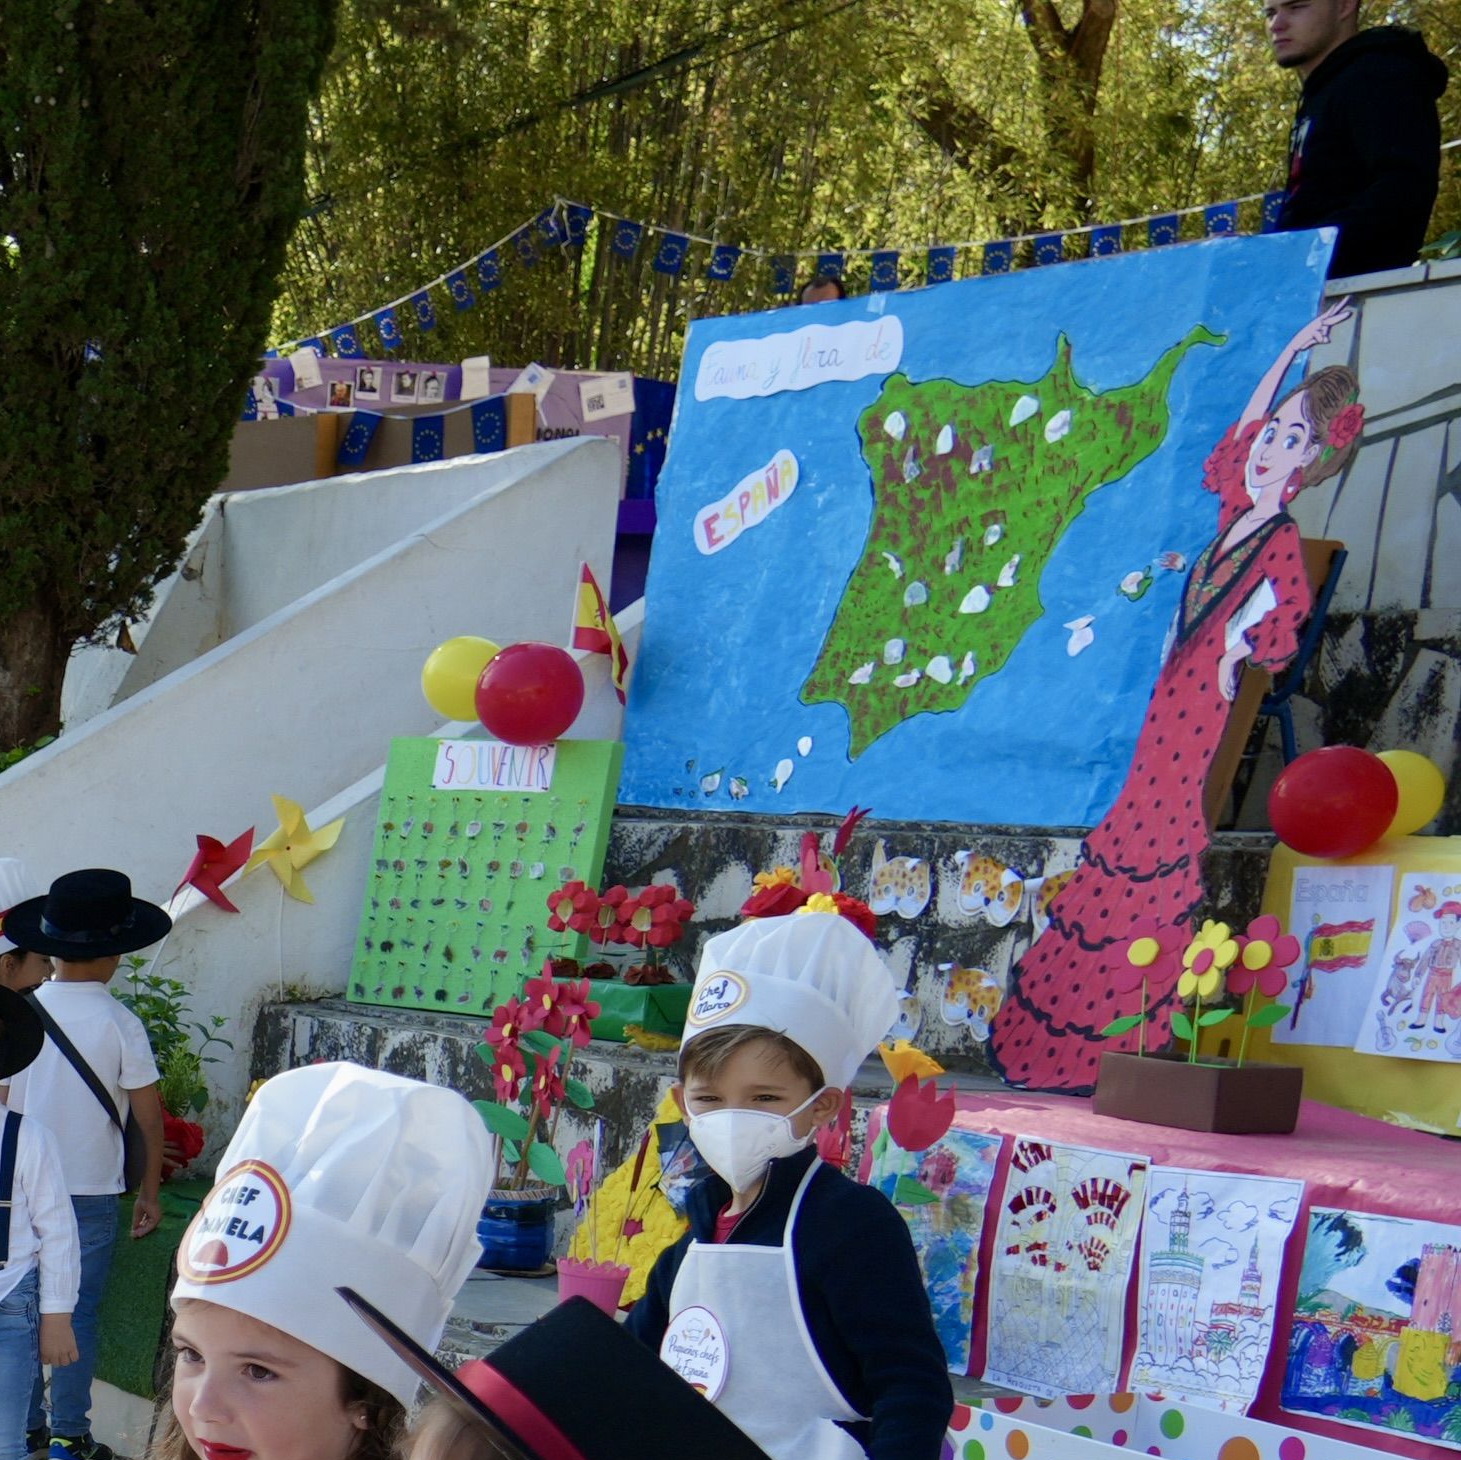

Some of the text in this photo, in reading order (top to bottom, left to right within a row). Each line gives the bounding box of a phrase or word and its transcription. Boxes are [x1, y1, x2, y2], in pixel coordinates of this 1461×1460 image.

[703, 460, 795, 549] ESPAÑA
[442, 746, 550, 787] SOUVENIR
[1295, 878, 1369, 907] España
[699, 980, 728, 1001] Chef
[694, 1001, 730, 1016] Marco
[221, 1186, 260, 1206] CHEF
